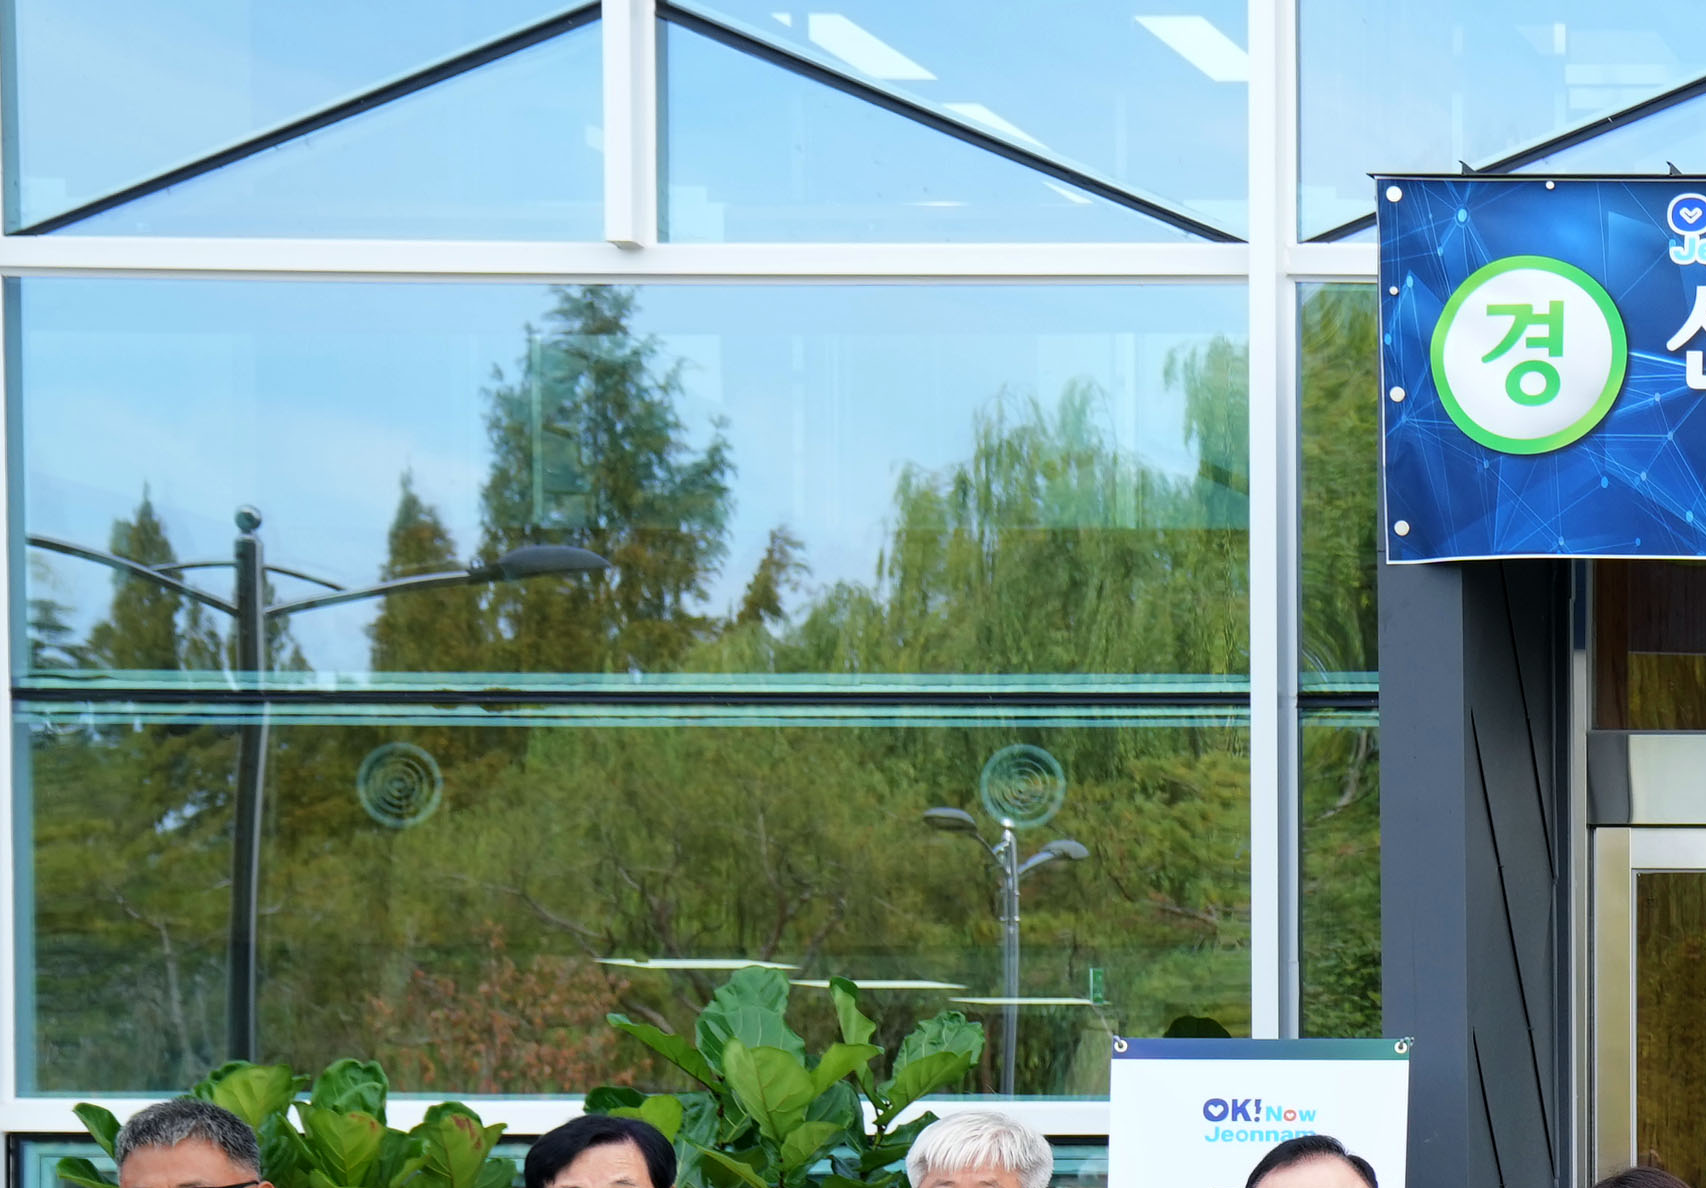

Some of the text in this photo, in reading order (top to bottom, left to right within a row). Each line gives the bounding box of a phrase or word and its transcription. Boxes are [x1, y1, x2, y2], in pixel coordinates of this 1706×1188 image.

[1481, 301, 1565, 405] 경
[1202, 1097, 1317, 1123] OK! Now
